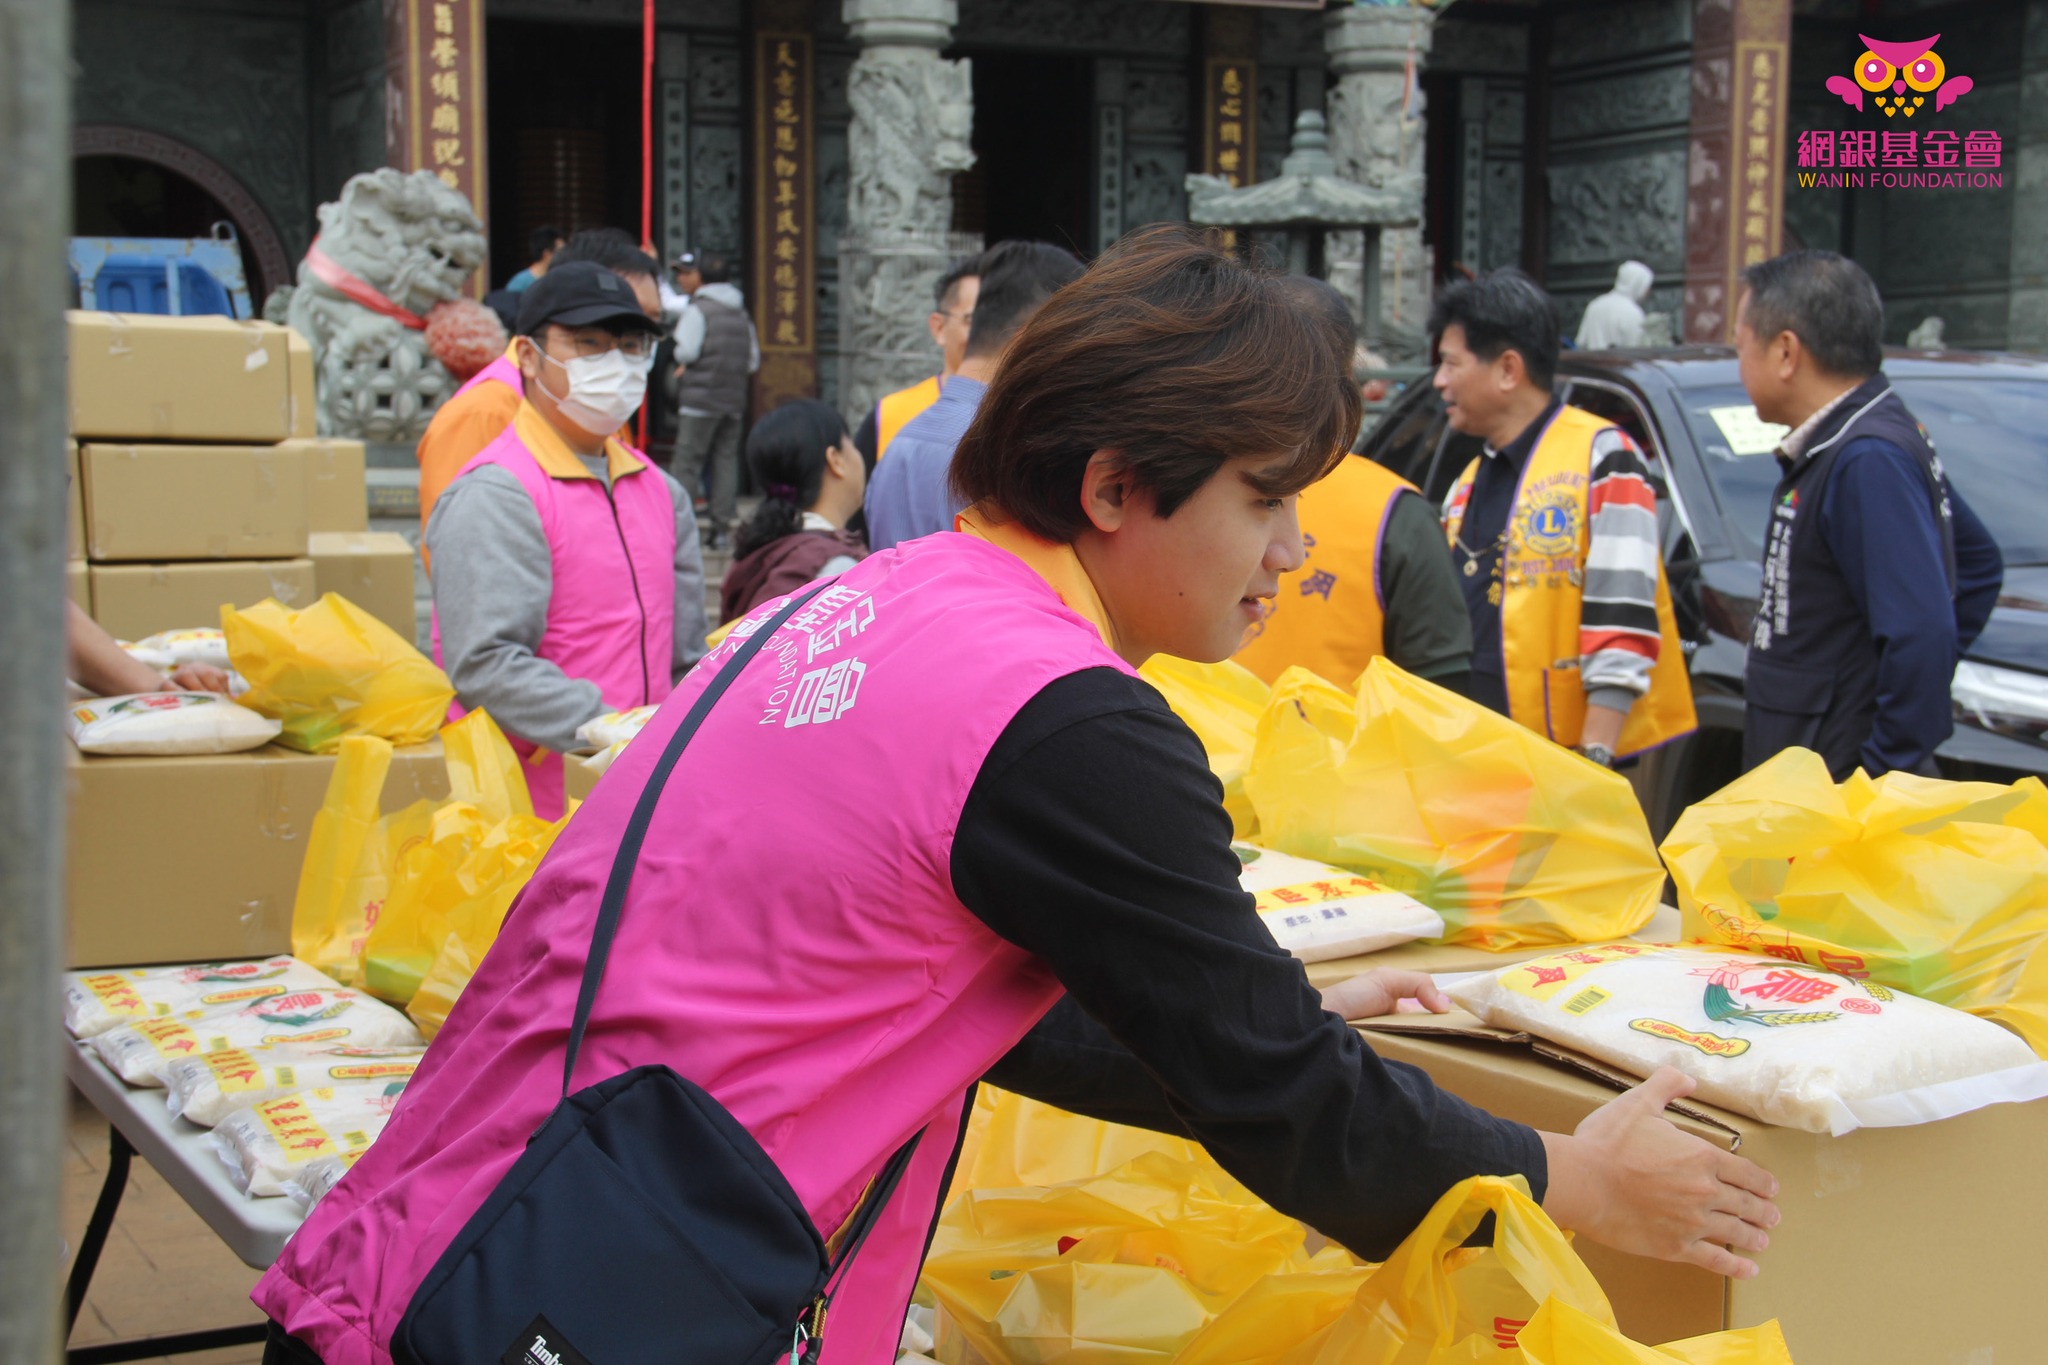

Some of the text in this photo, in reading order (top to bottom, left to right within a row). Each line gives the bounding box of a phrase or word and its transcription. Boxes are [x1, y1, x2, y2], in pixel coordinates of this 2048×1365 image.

[758, 634, 801, 726] OUNDATION
[1256, 876, 1384, 911] 區農會
[529, 1334, 564, 1365] Timb
